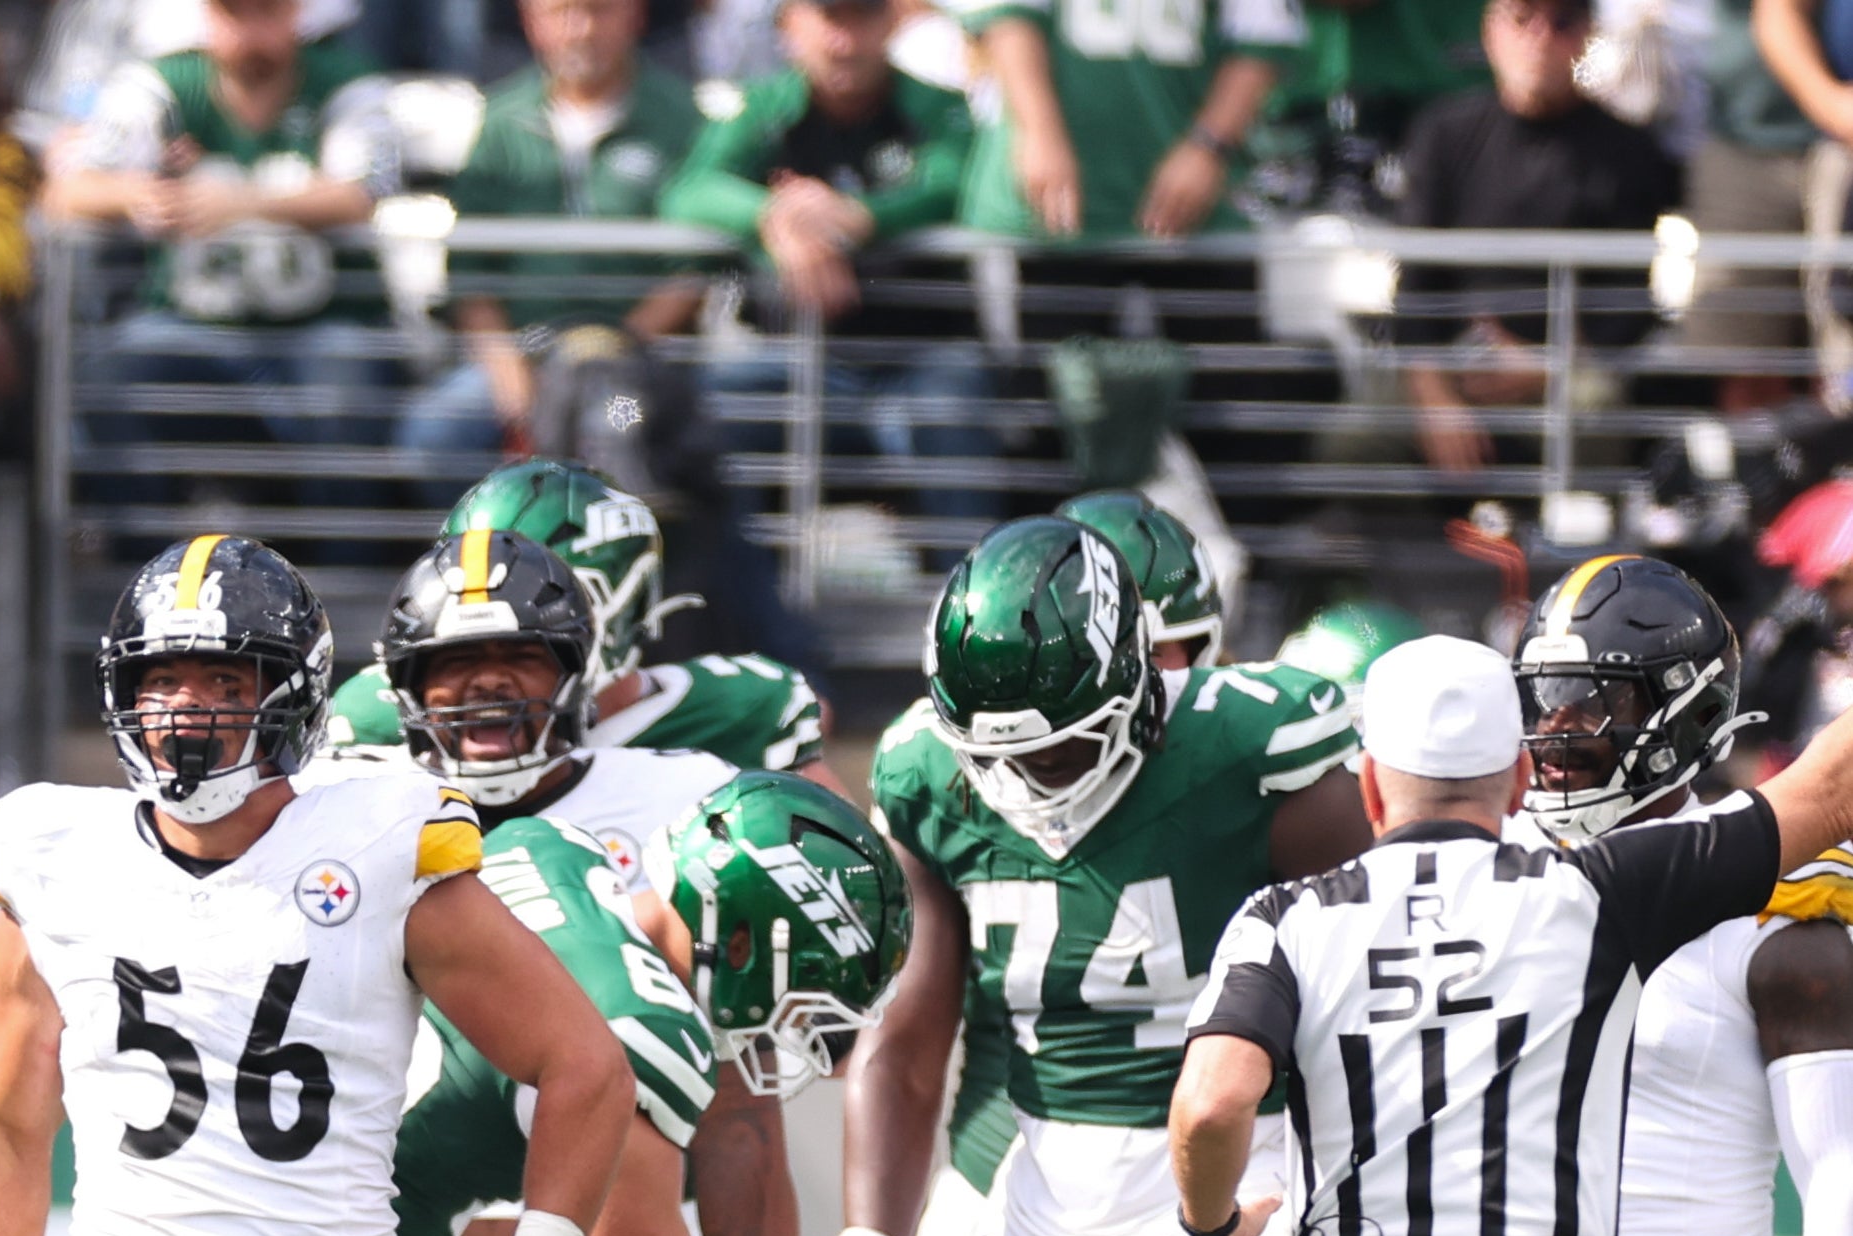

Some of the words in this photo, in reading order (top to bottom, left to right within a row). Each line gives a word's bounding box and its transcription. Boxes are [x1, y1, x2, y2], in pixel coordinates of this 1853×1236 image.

[738, 838, 877, 959] JETS
[1406, 894, 1448, 937] R
[958, 874, 1213, 1056] 74
[1367, 938, 1496, 1024] 52
[112, 956, 336, 1163] 56
